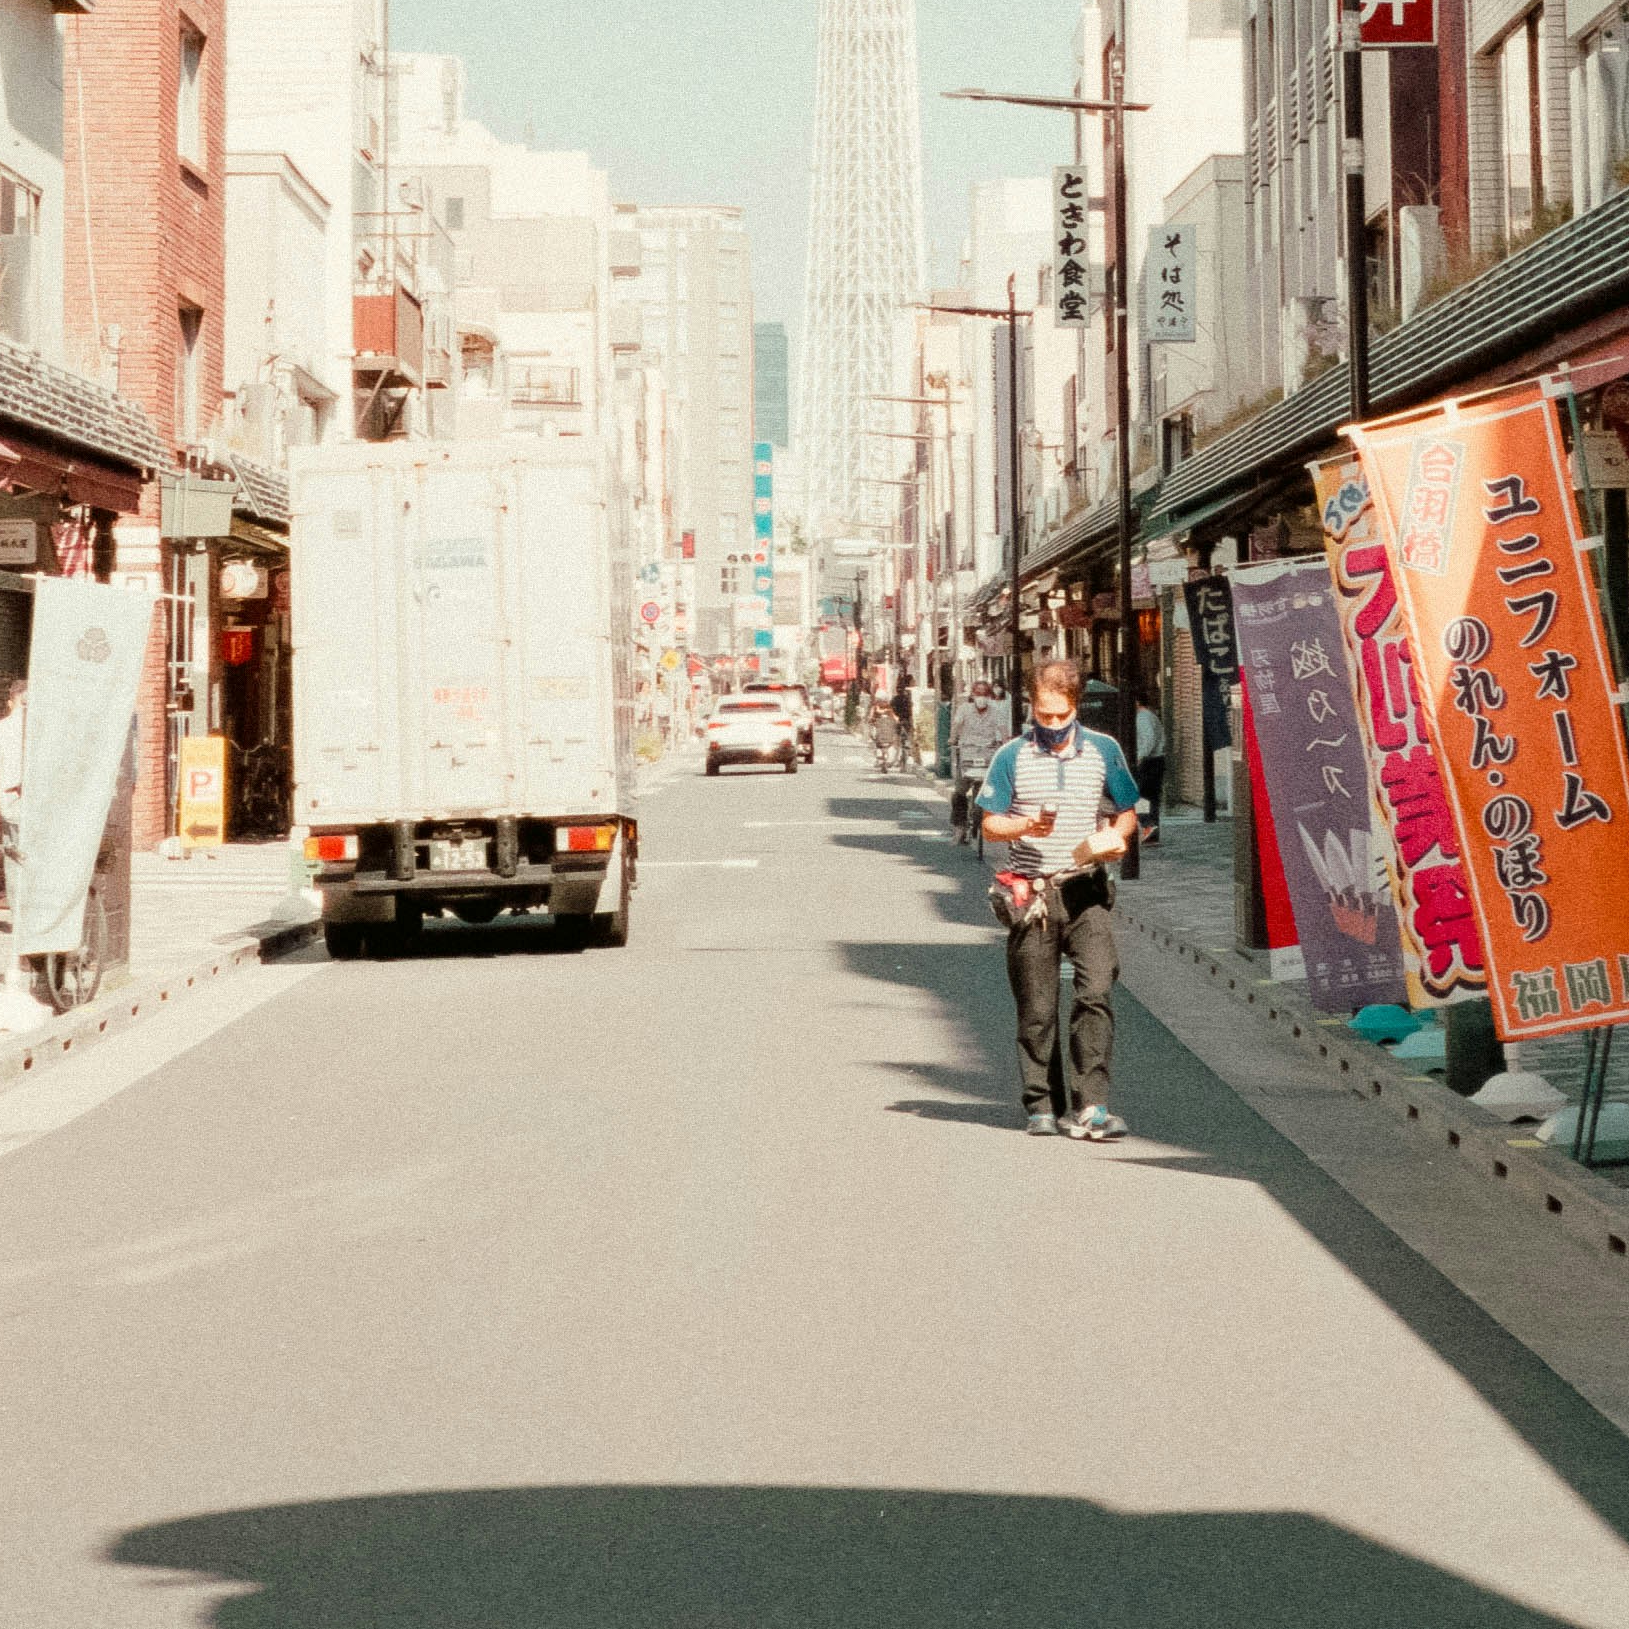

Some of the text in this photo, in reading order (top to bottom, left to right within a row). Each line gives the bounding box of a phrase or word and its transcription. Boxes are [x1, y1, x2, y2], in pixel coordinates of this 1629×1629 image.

[1058, 173, 1088, 322] ときわ食堂
[1404, 443, 1463, 571] 合羽橋
[1197, 586, 1234, 675] たばこ
[1484, 476, 1612, 829] ユニフォーム
[190, 771, 213, 798] P
[1445, 616, 1553, 942] のれん・のぼり
